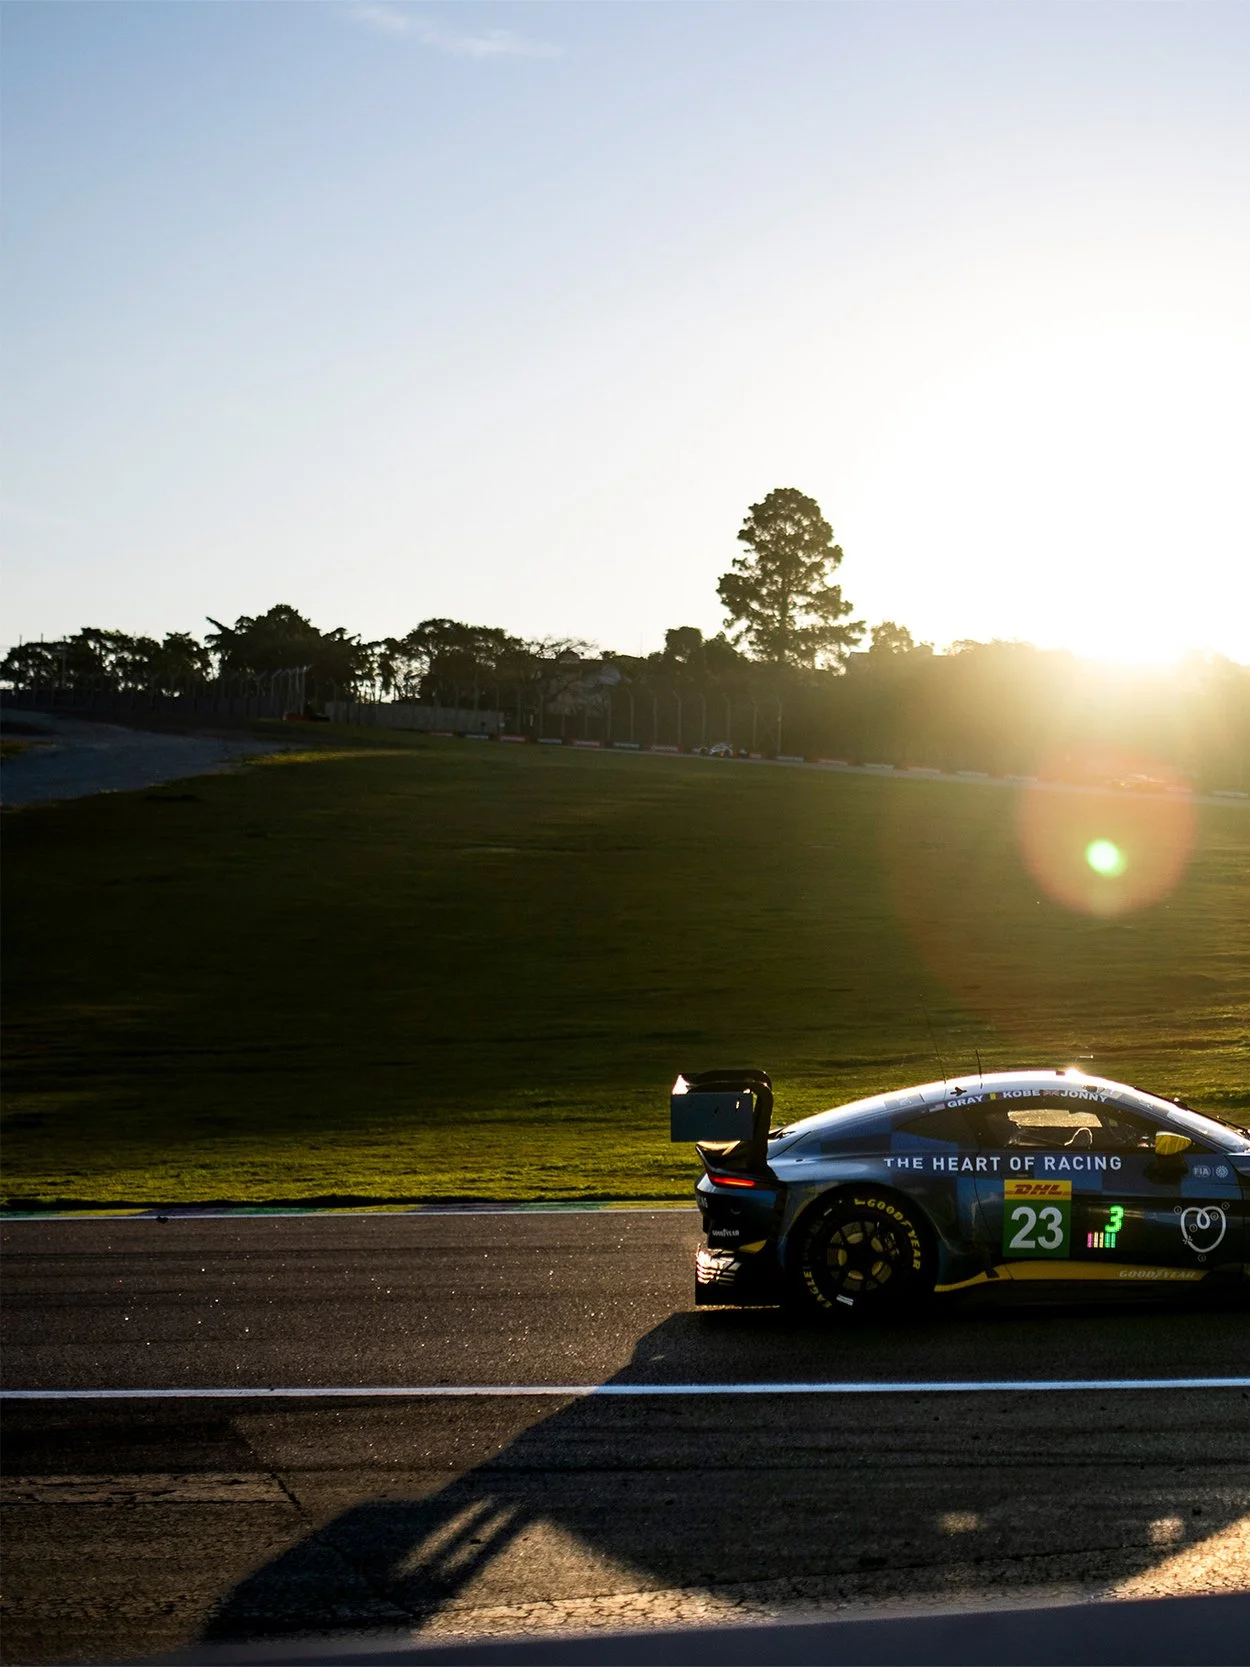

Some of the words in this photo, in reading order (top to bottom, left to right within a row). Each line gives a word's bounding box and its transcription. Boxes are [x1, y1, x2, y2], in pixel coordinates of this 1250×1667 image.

[946, 1094, 984, 1109] GRAY
[1002, 1089, 1041, 1099] KOBE
[1060, 1089, 1108, 1104] JONNY
[883, 1157, 924, 1170] THE
[932, 1156, 1002, 1172] HEART
[1009, 1156, 1036, 1172] OF
[1044, 1155, 1123, 1171] RACING
[1193, 1167, 1210, 1177] FIA
[1014, 1184, 1063, 1195] DHL
[1104, 1204, 1125, 1233] 3
[866, 1197, 923, 1271] GOODYEAR
[1009, 1206, 1064, 1250] 23
[1119, 1269, 1197, 1281] GOODYEAR
